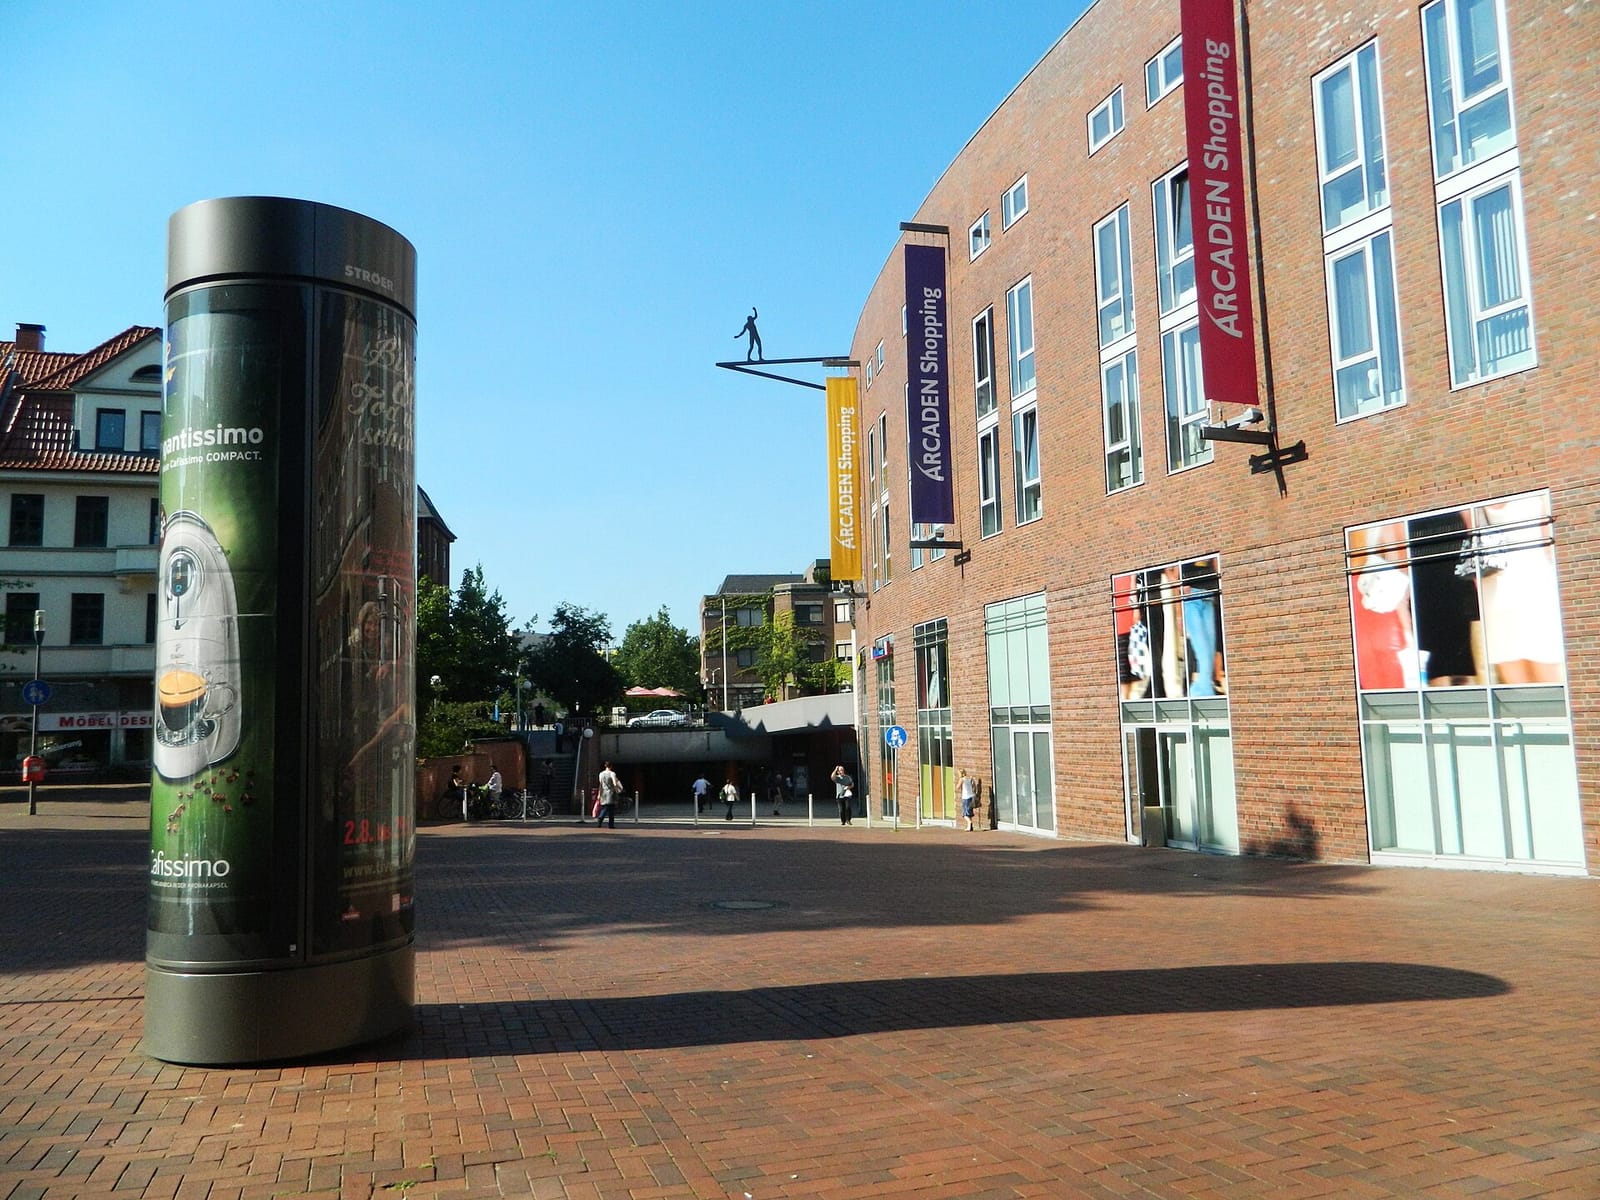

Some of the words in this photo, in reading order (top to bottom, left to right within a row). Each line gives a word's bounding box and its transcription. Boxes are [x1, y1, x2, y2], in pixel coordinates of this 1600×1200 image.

[1200, 38, 1233, 171] Shopping
[1203, 179, 1243, 338] ARCADEN
[919, 287, 943, 373] Shopping
[206, 451, 263, 462] COMPACT.
[837, 406, 856, 469] Shopping
[915, 379, 945, 482] ARCADEN
[835, 474, 857, 550] ARCADEN
[59, 715, 113, 727] MÖBEL
